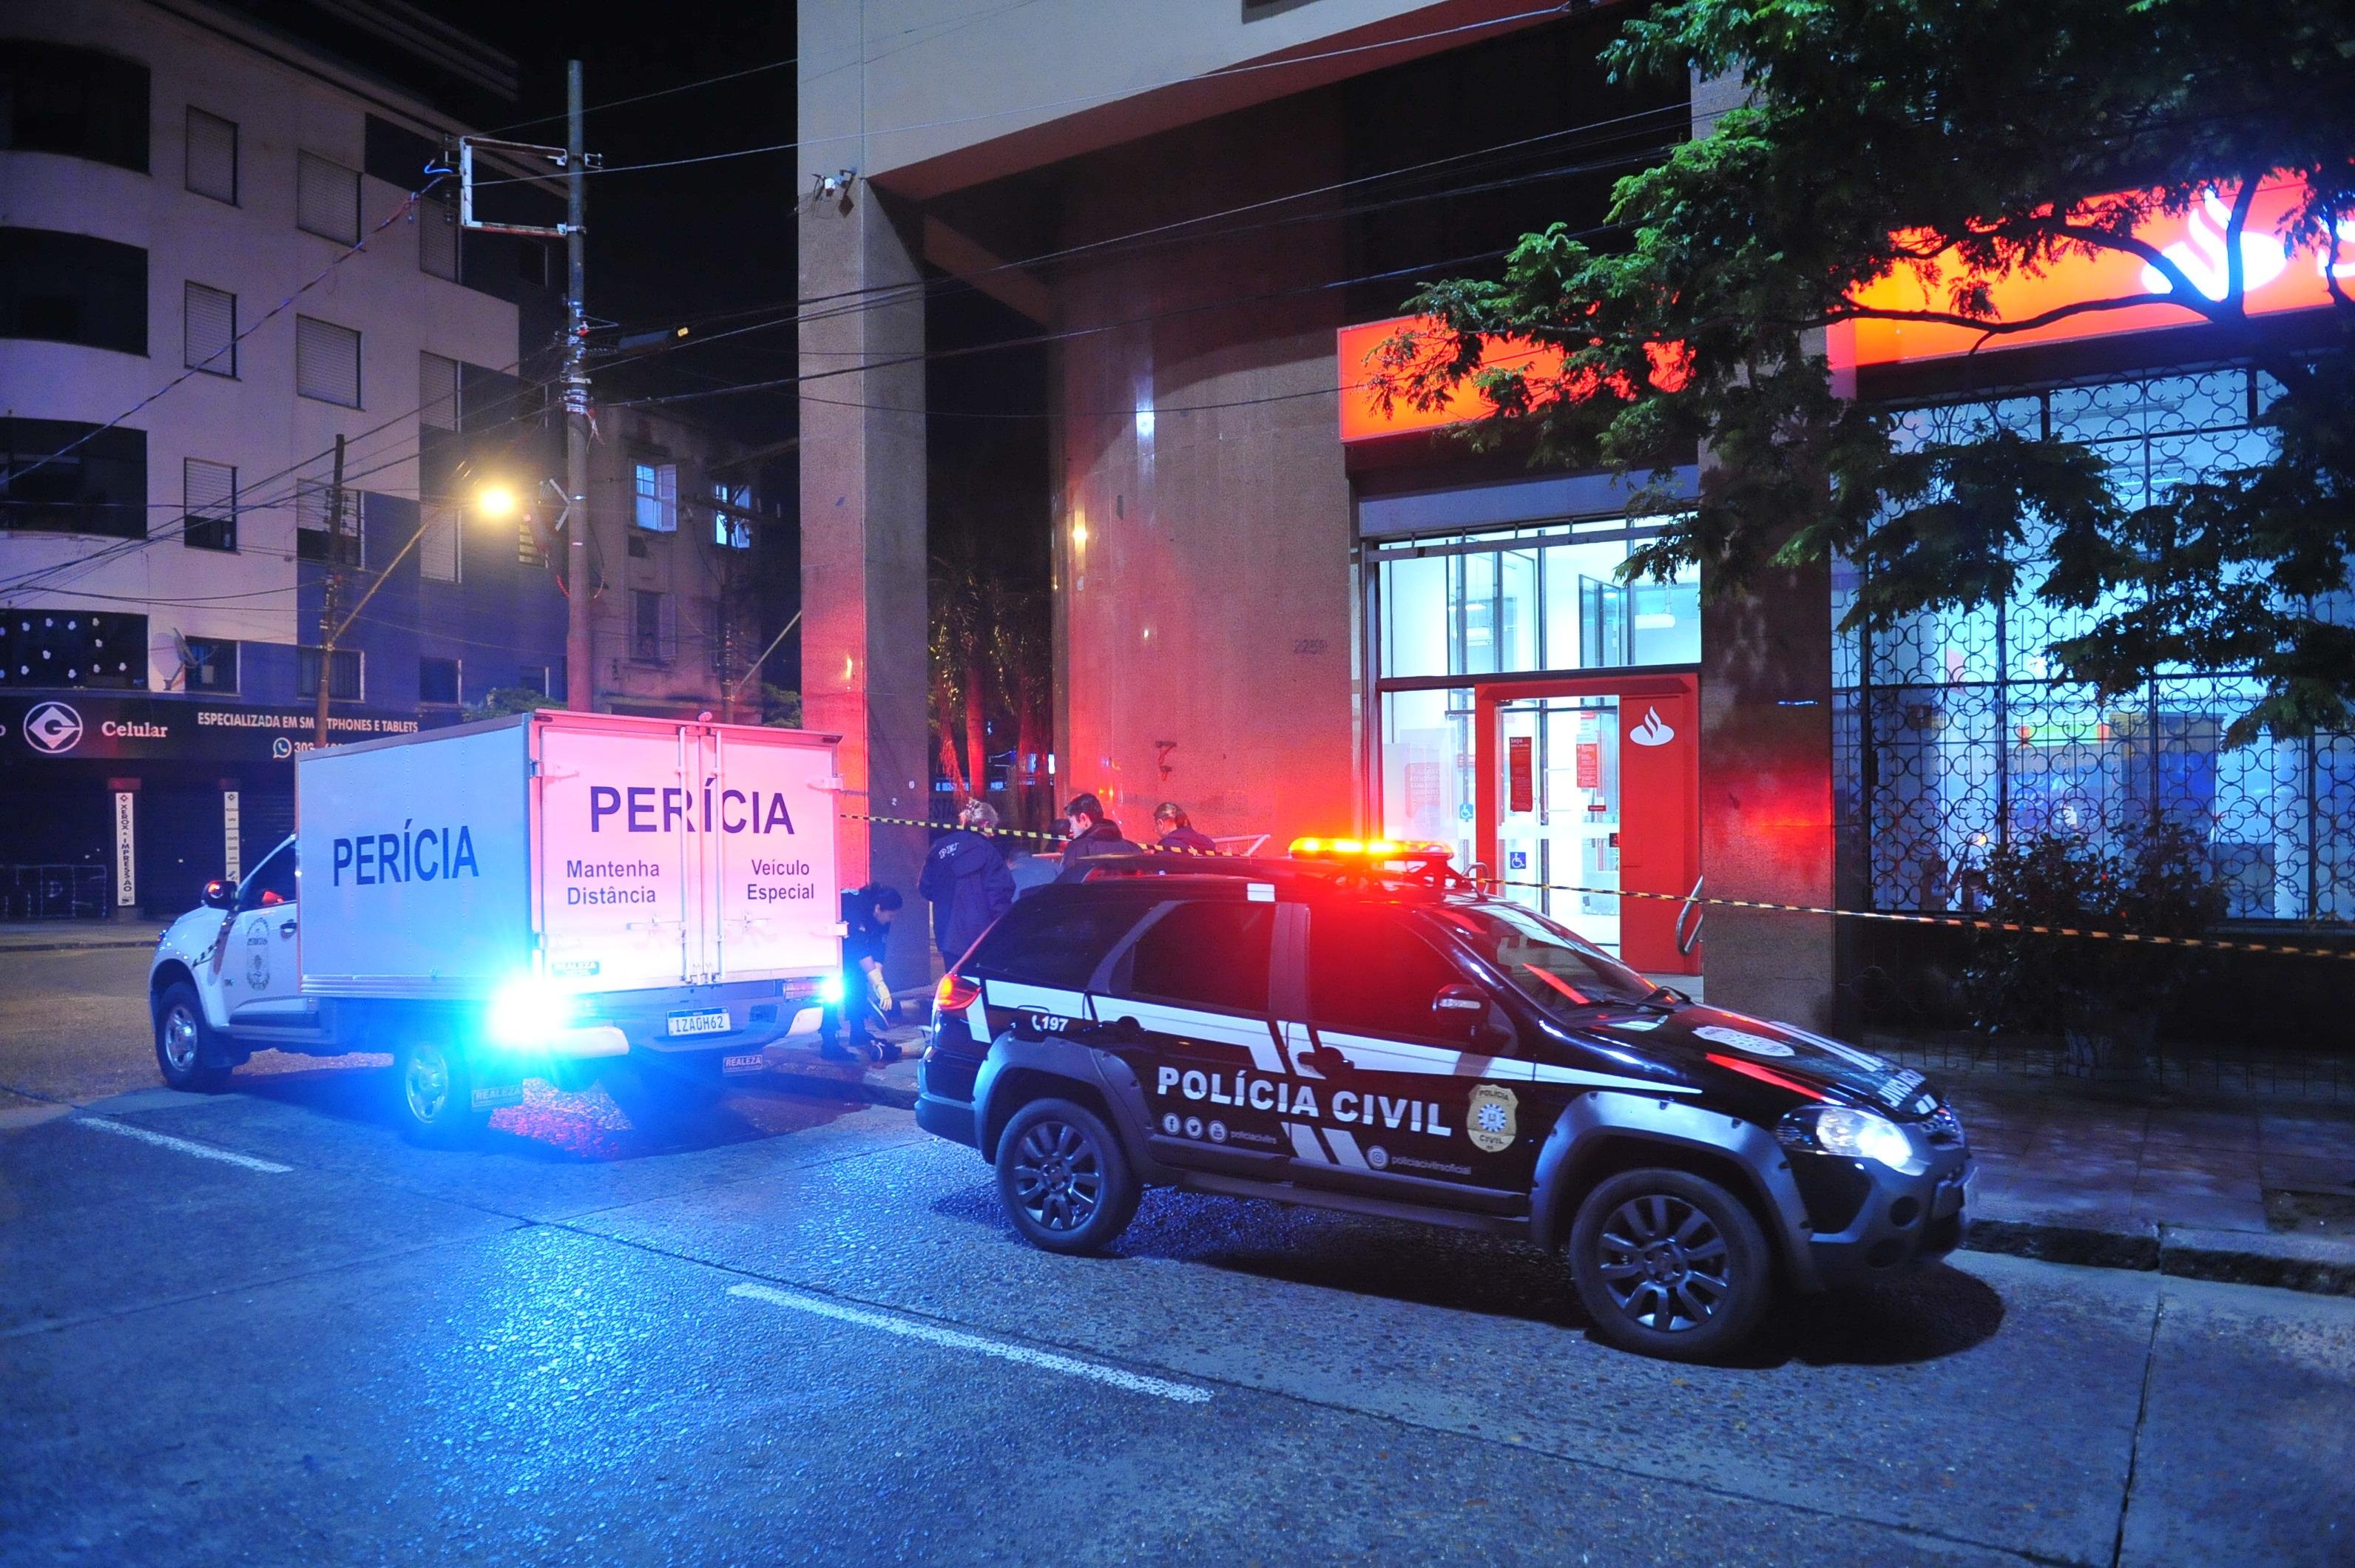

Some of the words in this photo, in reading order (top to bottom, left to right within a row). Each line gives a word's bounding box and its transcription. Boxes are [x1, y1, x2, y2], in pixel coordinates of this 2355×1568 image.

[102, 721, 169, 737] Celular
[197, 712, 281, 727] ESPECIALIZADA
[283, 717, 297, 728] EM
[300, 717, 372, 731] SMTPHONES
[374, 720, 380, 731] E
[382, 720, 419, 733] TABLETS
[590, 777, 795, 835] PERÍCIA
[121, 804, 129, 831] XEROX
[333, 819, 479, 886] PERÍCIA
[567, 860, 660, 878] Mantenha
[751, 859, 810, 876] Veículo
[567, 886, 656, 905] Distância
[747, 884, 814, 903] Especial
[1041, 1016, 1069, 1032] 197
[726, 1058, 761, 1067] REALEZA
[1157, 1067, 1320, 1118] POLÍCIA
[1331, 1091, 1452, 1137] CIVIL
